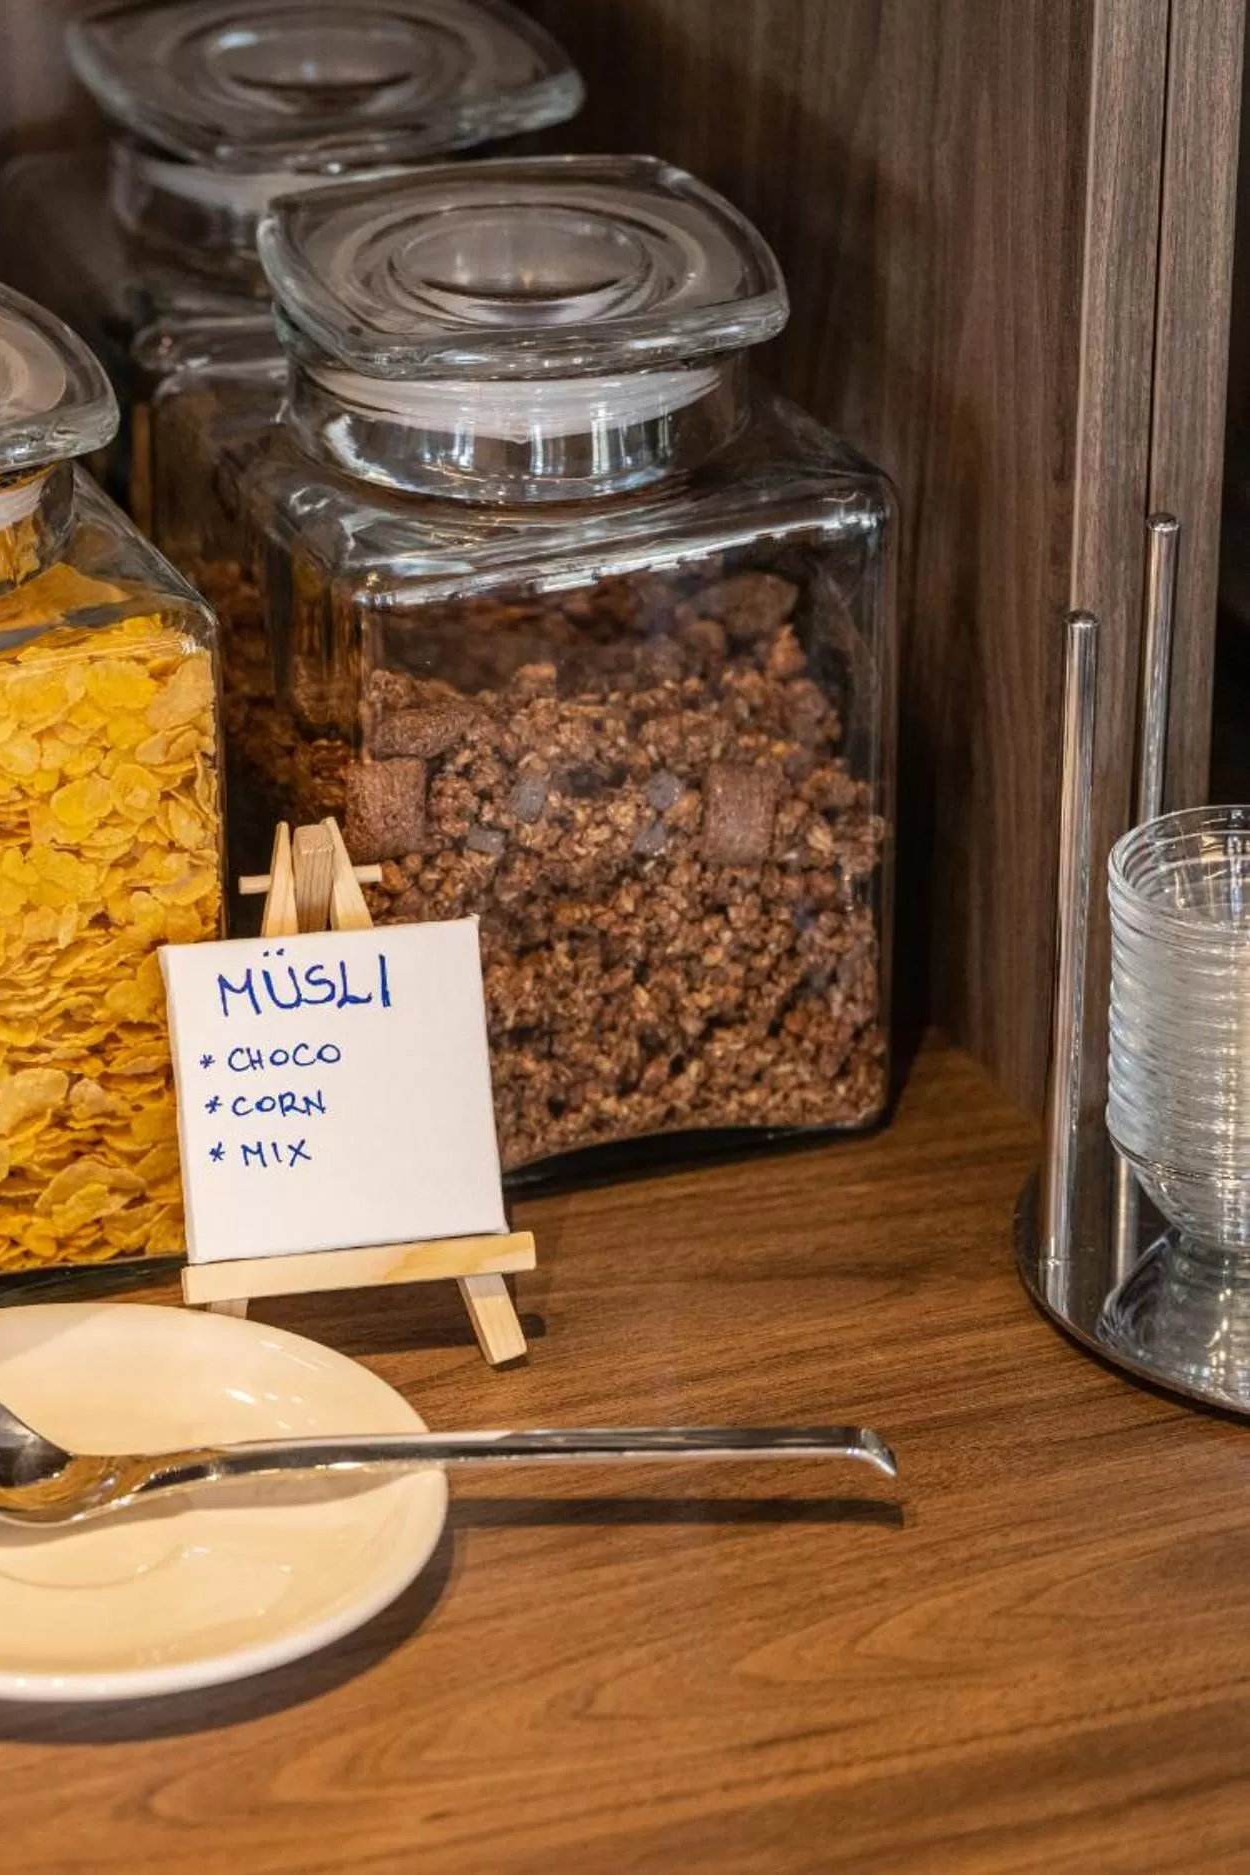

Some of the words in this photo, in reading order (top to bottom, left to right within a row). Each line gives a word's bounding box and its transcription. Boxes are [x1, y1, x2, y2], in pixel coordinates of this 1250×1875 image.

[217, 948, 391, 1016] MÜSLI
[227, 1043, 342, 1072] CHOCO
[231, 1090, 327, 1117] CORN
[240, 1139, 312, 1168] MIX
